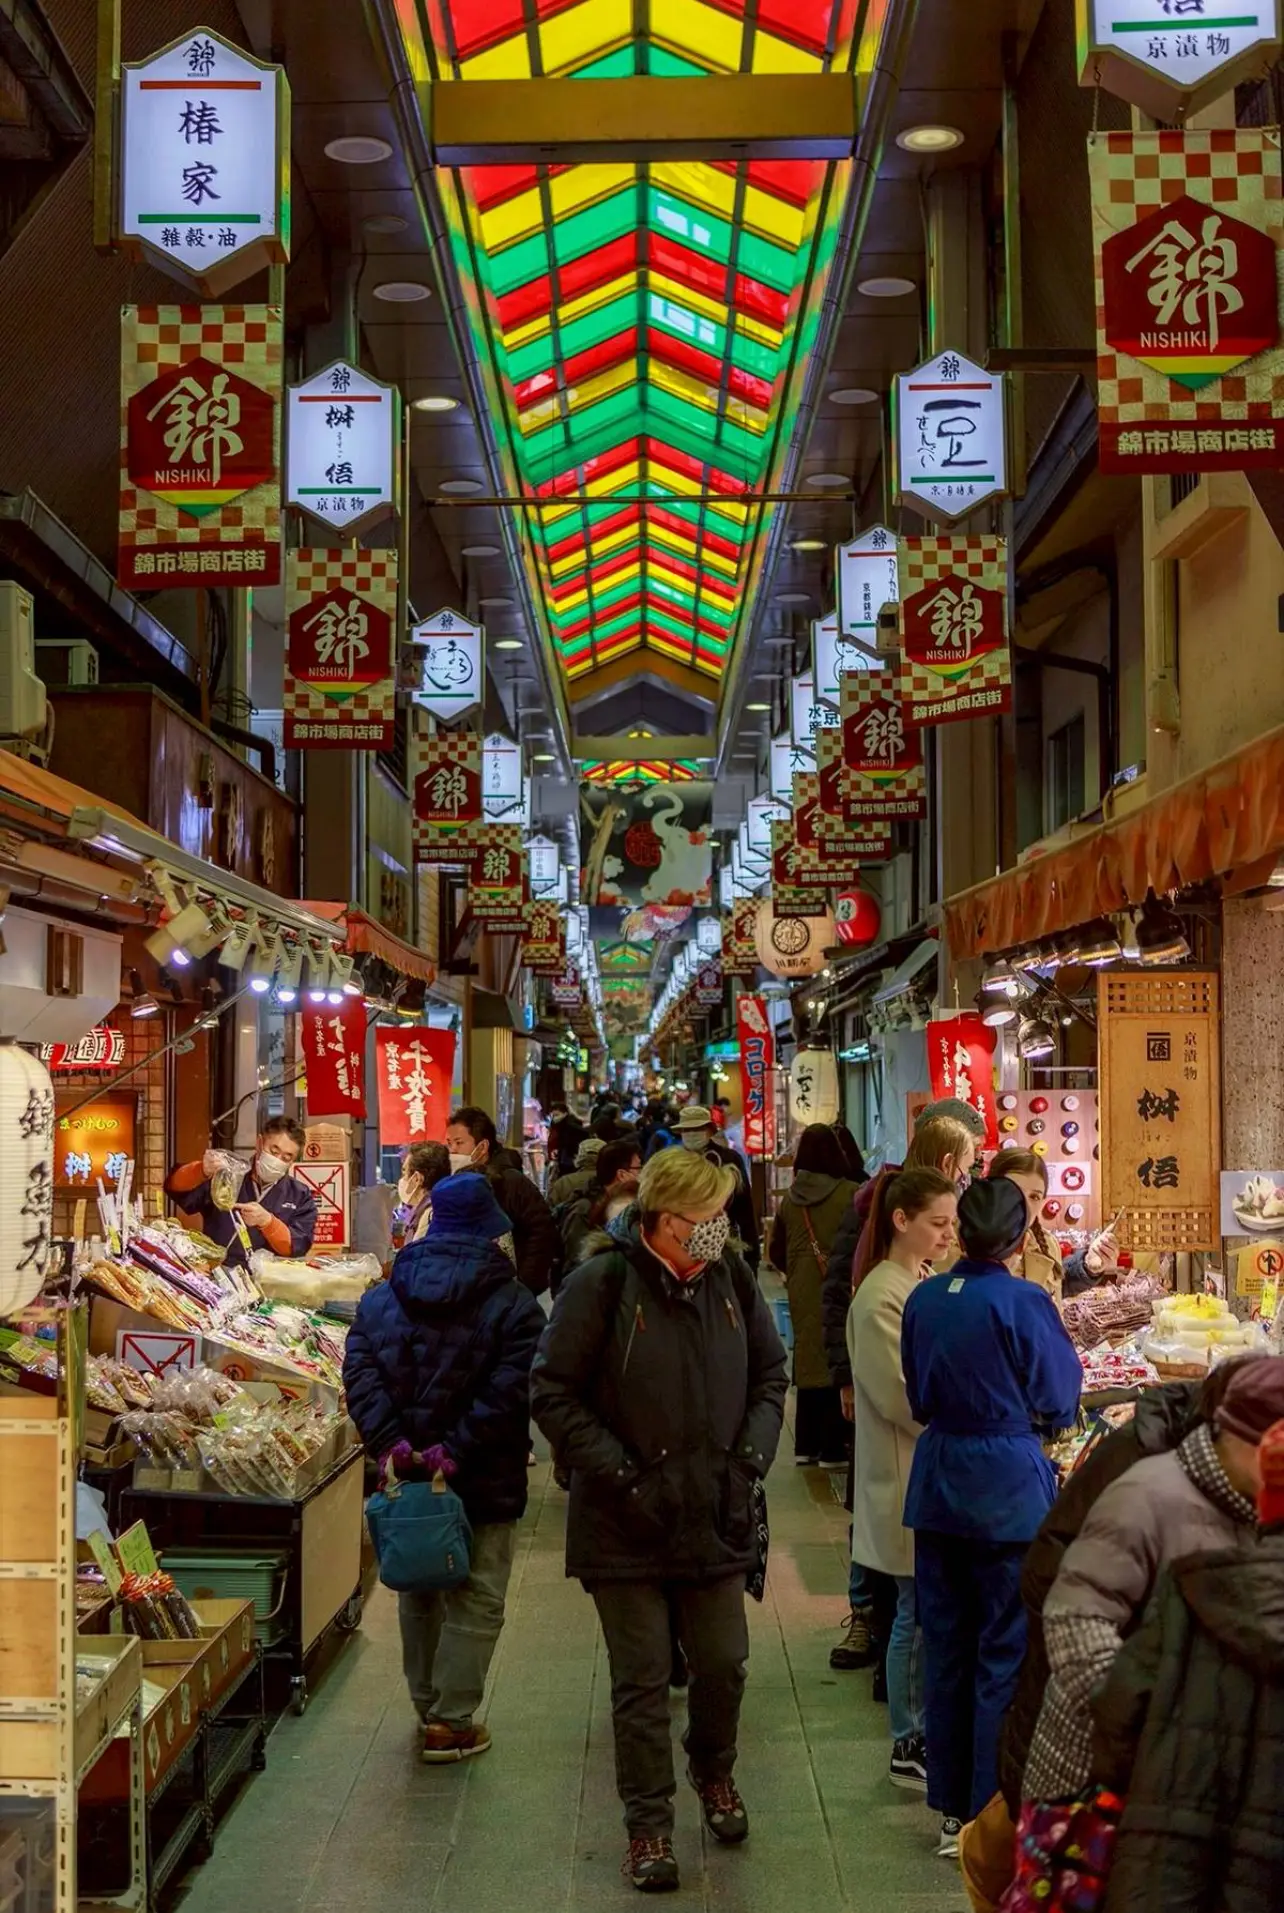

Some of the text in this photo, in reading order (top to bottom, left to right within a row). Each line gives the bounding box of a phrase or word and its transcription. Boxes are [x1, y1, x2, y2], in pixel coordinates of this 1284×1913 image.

[182, 40, 215, 77] 錦
[1147, 33, 1230, 58] 京漬物
[178, 100, 224, 206] 椿家
[1125, 214, 1244, 353] 錦
[1140, 330, 1207, 349] NISHIKI
[327, 367, 350, 393] 錦
[146, 373, 244, 487] 錦
[916, 416, 936, 468] せんべい
[1117, 427, 1276, 457] 錦市場商店街
[155, 468, 211, 484] NISHIKI
[316, 497, 365, 512] 京漬物
[134, 549, 266, 575] 錦市場商店街
[302, 599, 370, 681] 錦
[917, 584, 984, 659] 錦
[308, 667, 348, 678] NISHIKI
[926, 649, 965, 661] NISHIKI
[912, 690, 1002, 721] 錦市場商店街
[293, 724, 385, 741] 錦市場商店街
[853, 706, 906, 768] 錦
[423, 766, 468, 819] 錦
[483, 847, 512, 886] 錦
[1183, 1031, 1198, 1081] 京漬物
[745, 1037, 766, 1115] コロッケ
